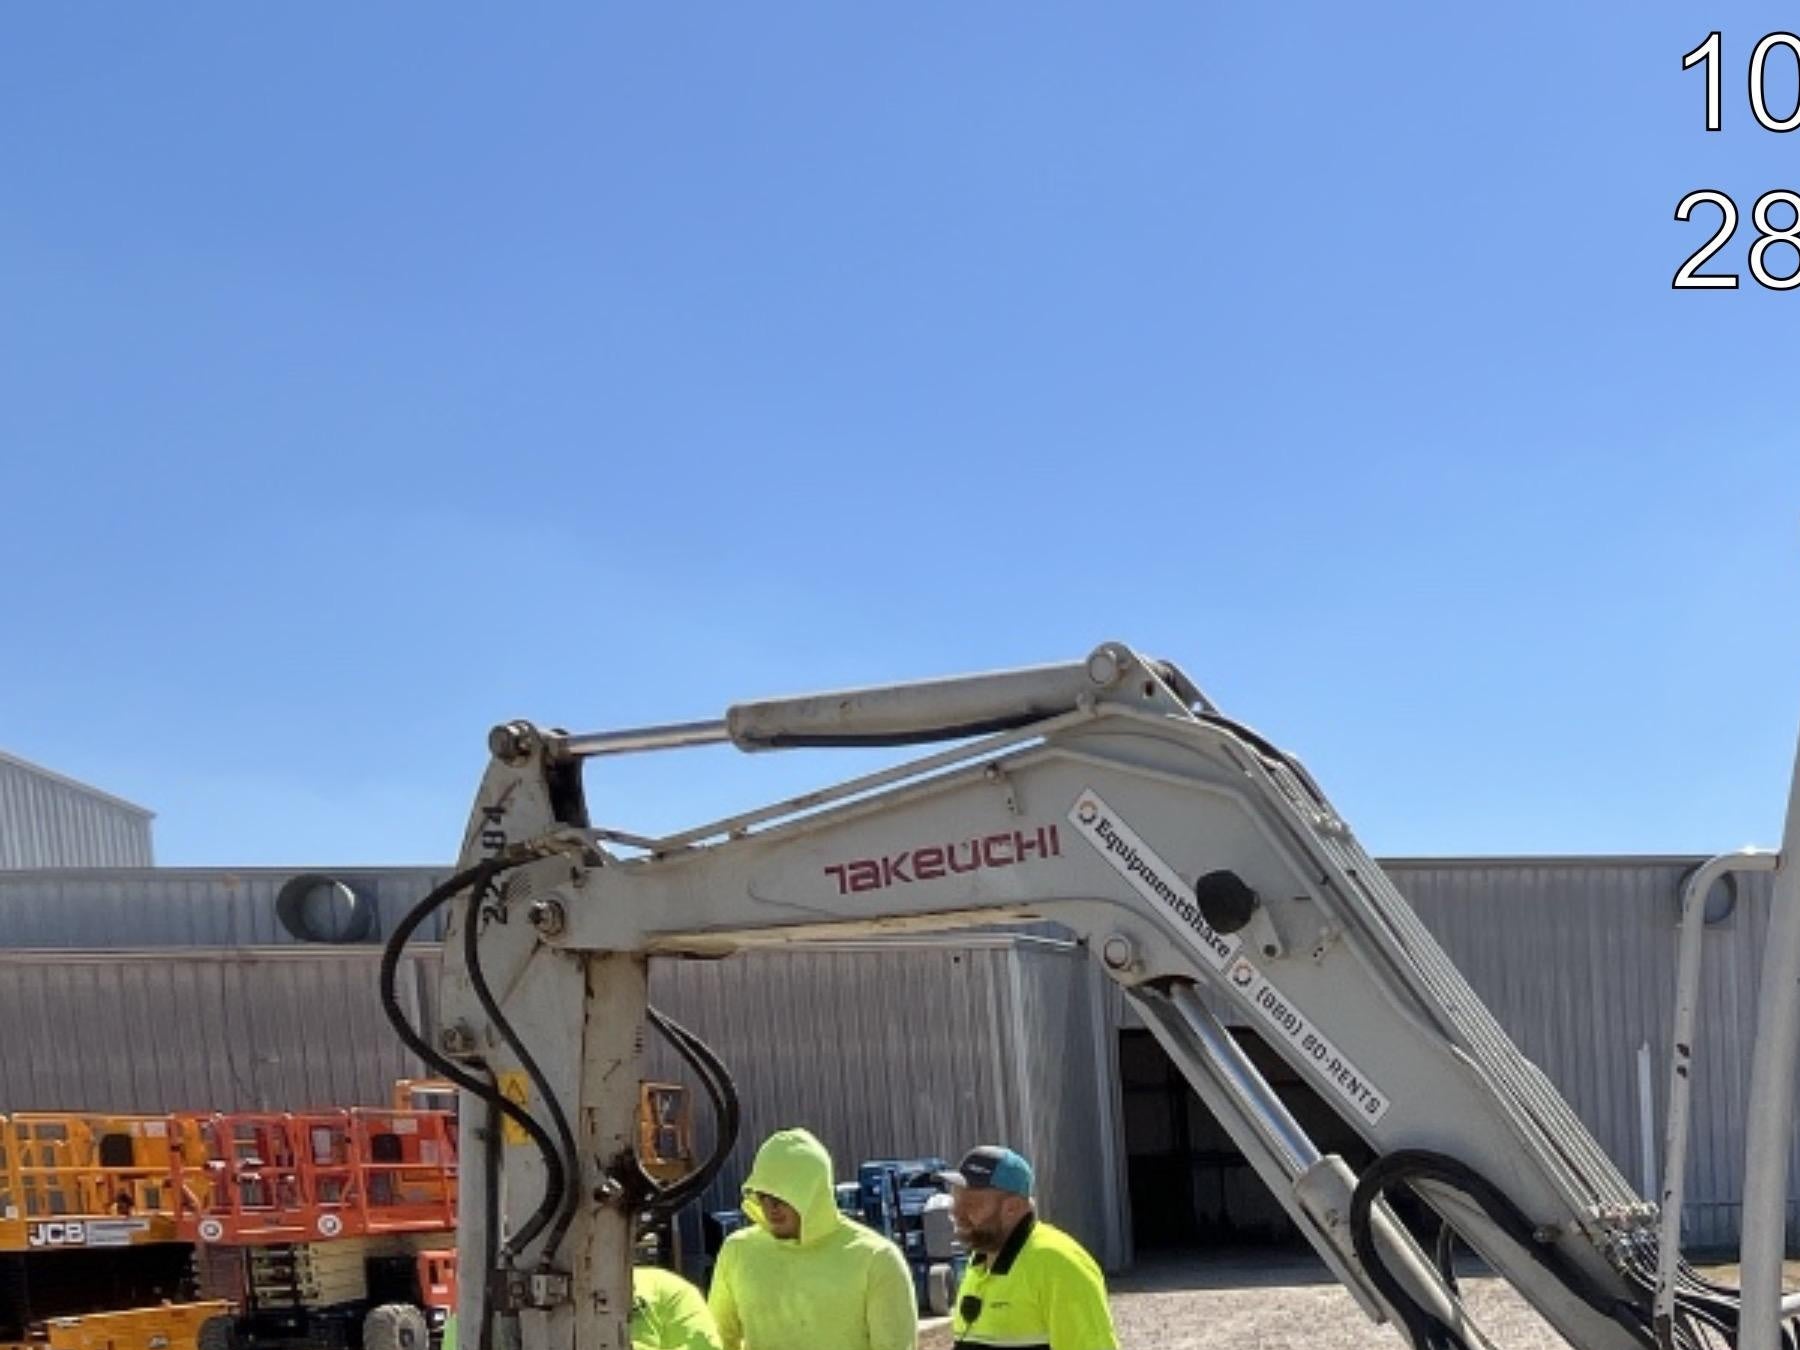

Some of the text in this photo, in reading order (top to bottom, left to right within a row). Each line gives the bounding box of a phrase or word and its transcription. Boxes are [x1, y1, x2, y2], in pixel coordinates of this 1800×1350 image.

[1094, 817, 1231, 958] EquipmentShare
[1256, 985, 1303, 1036] (888)
[29, 1222, 86, 1246] JCB
